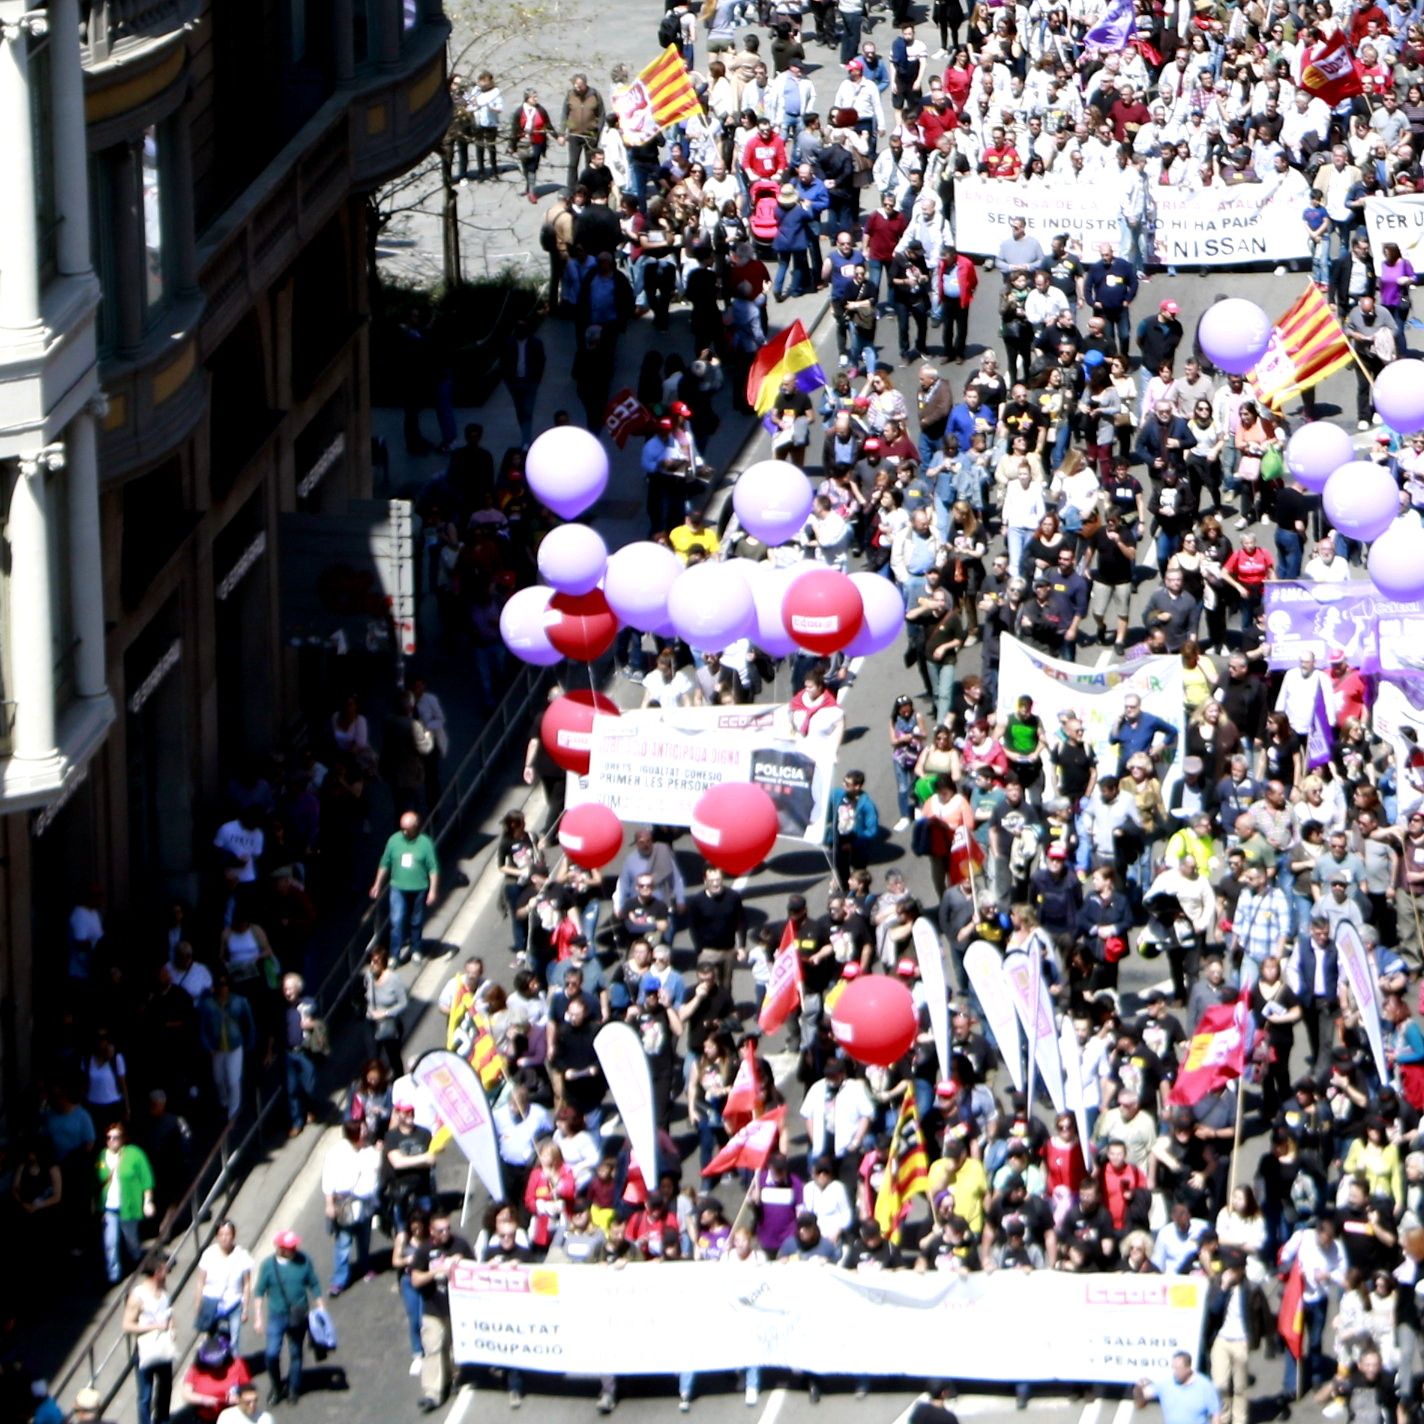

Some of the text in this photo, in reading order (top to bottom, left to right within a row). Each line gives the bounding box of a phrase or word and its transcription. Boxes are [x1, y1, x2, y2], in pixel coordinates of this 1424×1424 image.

[1376, 214, 1408, 230] PER
[1174, 237, 1267, 258] NISSAN
[600, 772, 641, 786] PRIMER
[755, 762, 804, 781] POLICIA
[474, 1320, 561, 1334] IGUALTAT
[1104, 1336, 1179, 1347] SALARIS
